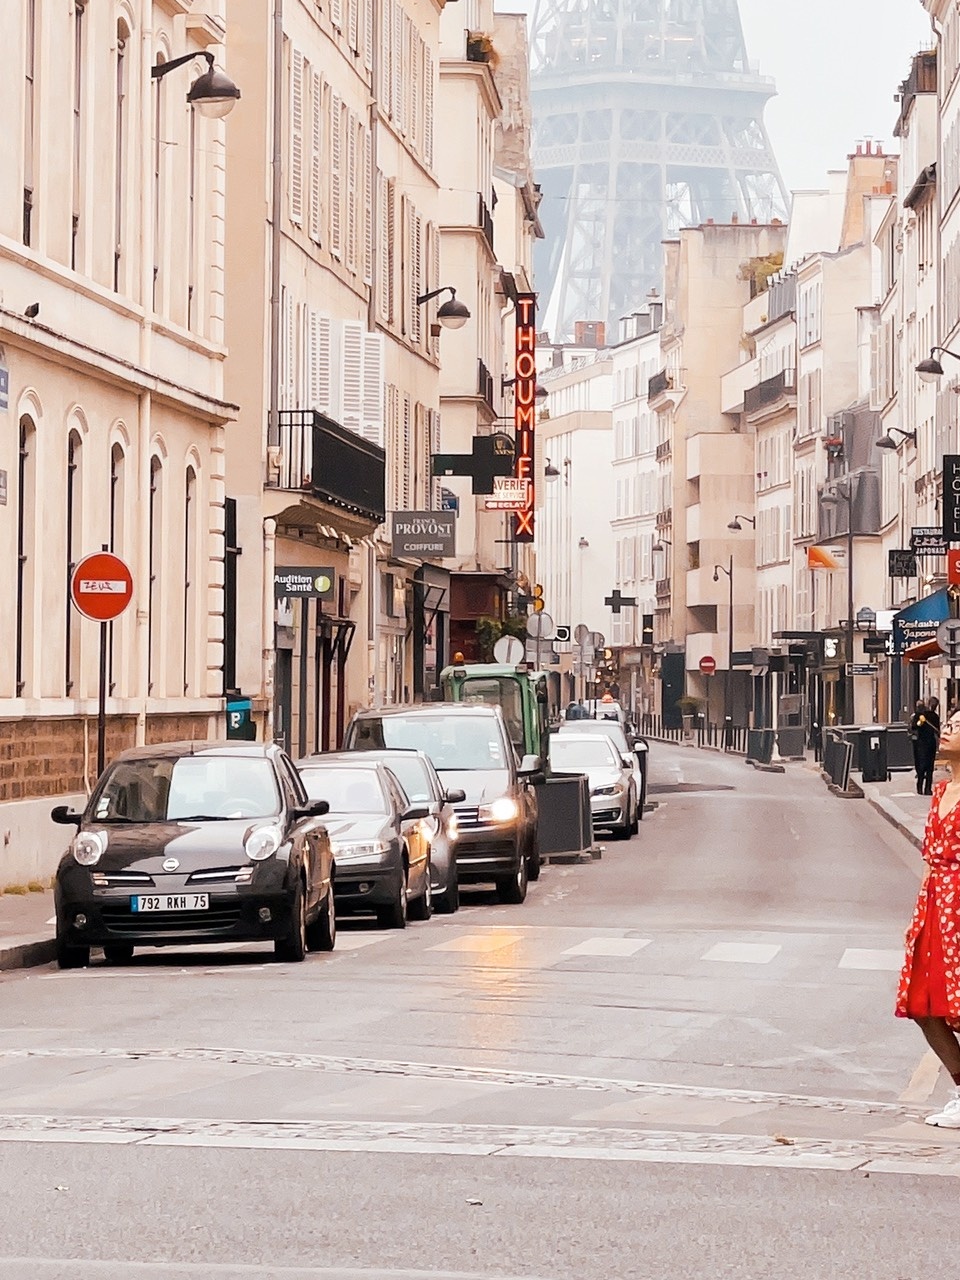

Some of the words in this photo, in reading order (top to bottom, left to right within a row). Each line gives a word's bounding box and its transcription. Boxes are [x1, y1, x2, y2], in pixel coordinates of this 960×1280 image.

[493, 480, 525, 491] AVERIE
[395, 523, 453, 535] PROVOST
[403, 543, 444, 551] COIFFURE
[274, 575, 312, 584] Audition
[285, 583, 312, 592] Santé
[141, 897, 160, 910] 792
[193, 895, 206, 908] 75
